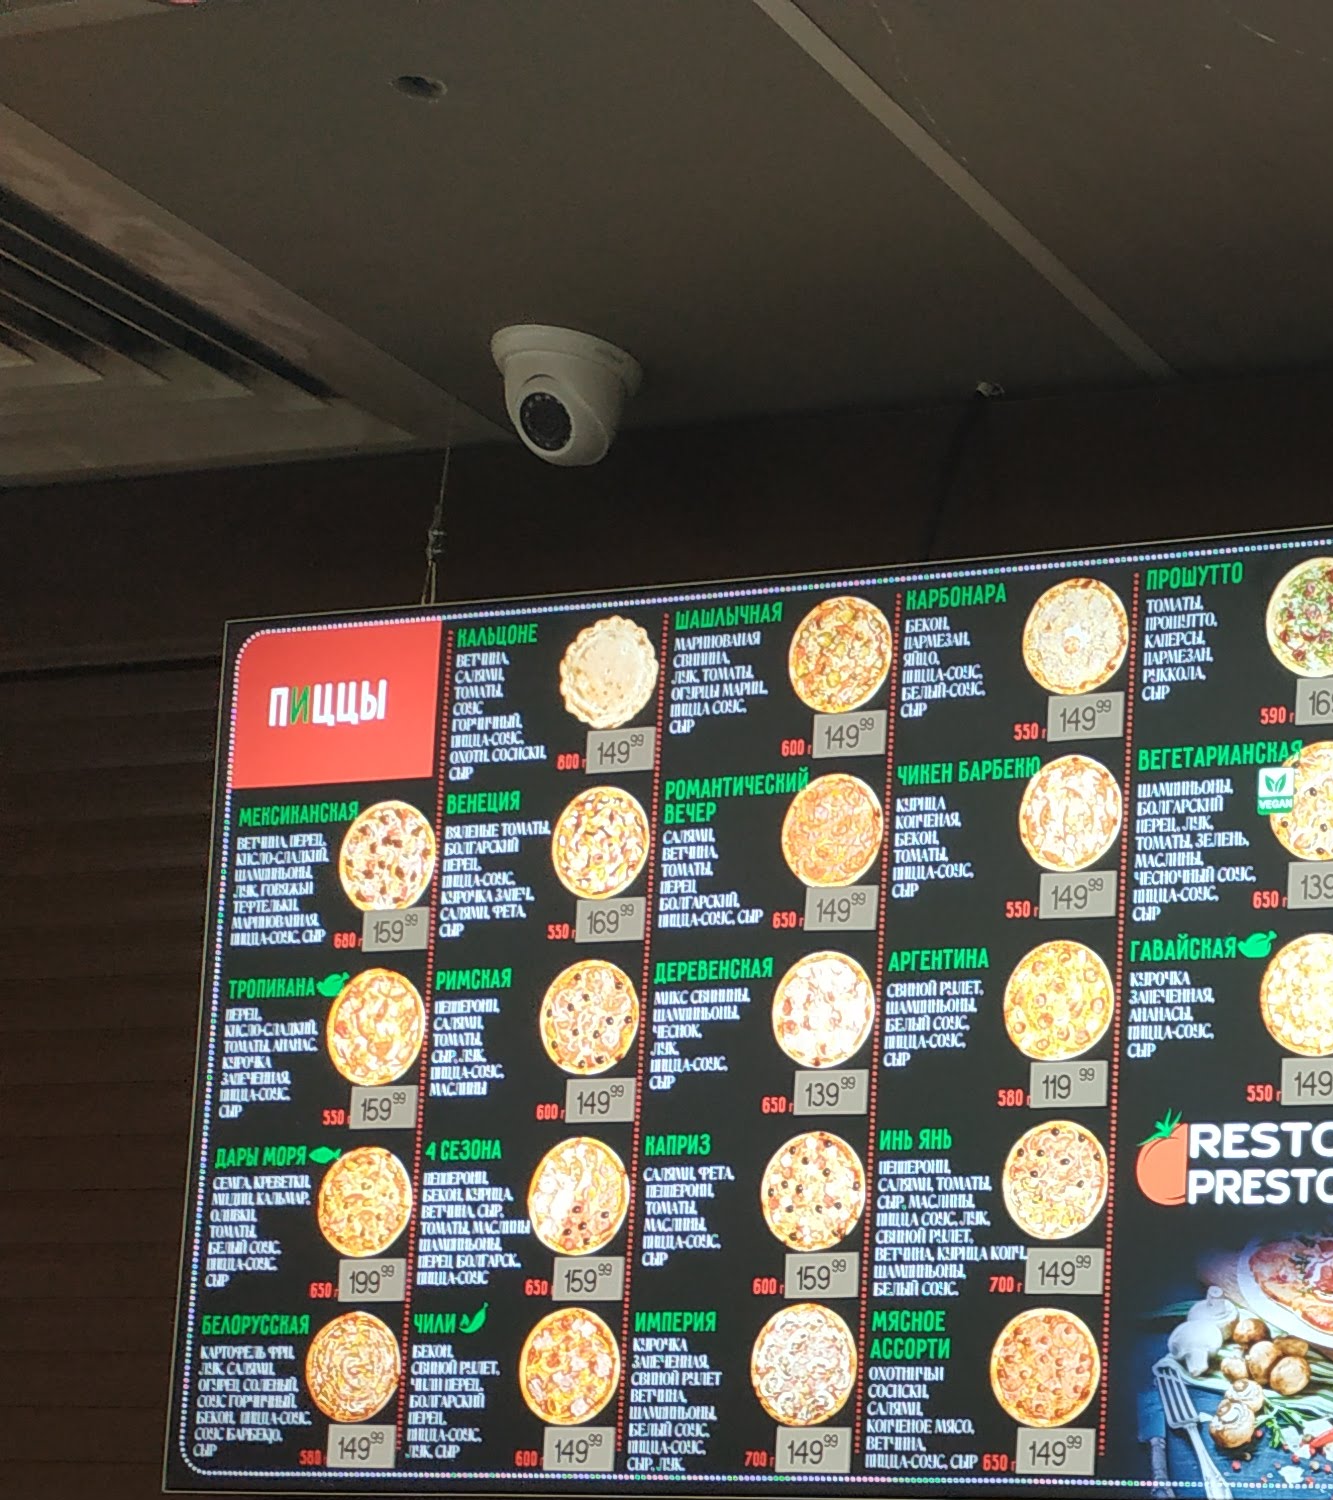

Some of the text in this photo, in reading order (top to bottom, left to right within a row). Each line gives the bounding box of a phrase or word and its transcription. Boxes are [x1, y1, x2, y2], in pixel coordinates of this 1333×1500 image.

[1147, 562, 1242, 590] ПРОШУТТО
[906, 583, 1006, 610] КАРБОНАРА
[675, 602, 782, 630] ШАШЛЫЧНАЯ
[458, 624, 538, 647] КАЛЬЦОНЕ
[268, 679, 389, 727] ПИЦЦЫ
[1138, 740, 1303, 771] ВЕГЕТАРИАНСКАЯ
[897, 756, 1041, 785] ЧИКЕН БАРБЕКЮ
[665, 767, 809, 803] РОМАНТИЧЕСКИЙ
[239, 801, 359, 826] МЕКСИКАНСКАЯ
[447, 790, 520, 814] ВЕНЕЦИЯ
[664, 802, 716, 824] ВЕЧЕР
[1130, 933, 1240, 962] ГАВАЙСКАЯ
[654, 957, 773, 984] ДЕРЕВЕНСКАЯ
[888, 948, 989, 971] АРГЕНТИНА
[229, 977, 317, 999] ТРОПИКАНА
[436, 968, 512, 990] РИМСКАЯ
[425, 1139, 501, 1161] 4 СЕЗОНА
[645, 1133, 710, 1156] КАПРИЗ
[879, 1128, 952, 1150] ИНЬ ЯНЬ
[215, 1146, 307, 1168] ДАРЫ МОРЯ
[202, 1315, 309, 1335] БЕЛОРУССКАЯ
[414, 1314, 456, 1333] ЧИЛИ
[635, 1311, 716, 1332] ИМПЕРИЯ
[872, 1310, 945, 1332] МЯСНОЕ
[870, 1337, 950, 1359] АССОРТИ
